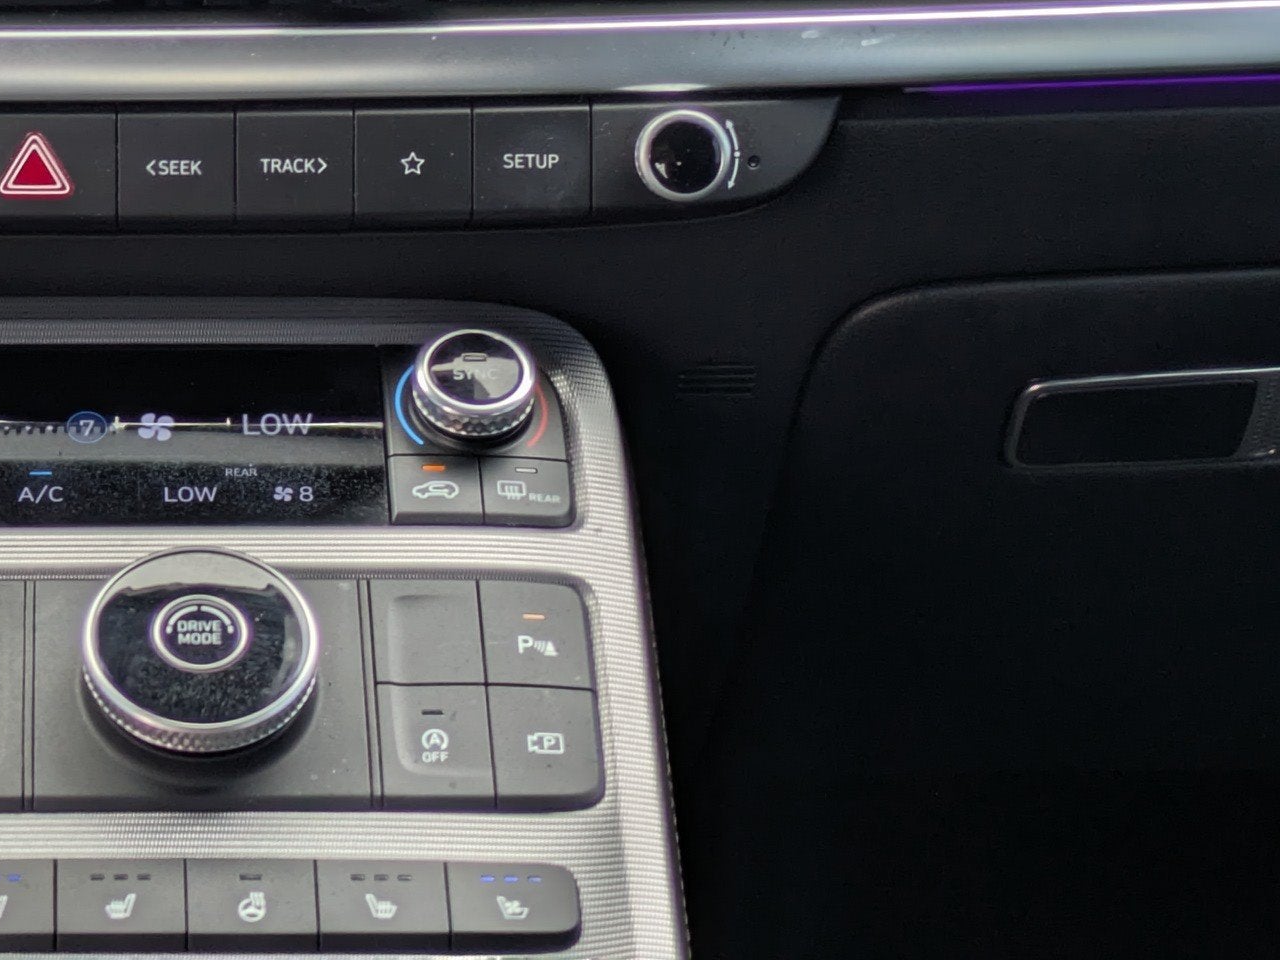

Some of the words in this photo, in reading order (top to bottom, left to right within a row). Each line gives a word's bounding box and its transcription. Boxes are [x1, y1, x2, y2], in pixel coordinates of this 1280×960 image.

[503, 152, 559, 170] SETUP
[79, 419, 95, 437] 7
[242, 413, 312, 436] LOW
[225, 467, 258, 477] REAR
[18, 485, 63, 504] A/C
[164, 486, 217, 503] LOW
[300, 486, 314, 503] 8
[529, 493, 561, 504] REAR
[177, 620, 221, 632] DRIVE
[177, 632, 222, 645] MODE
[421, 751, 449, 763] OFF
